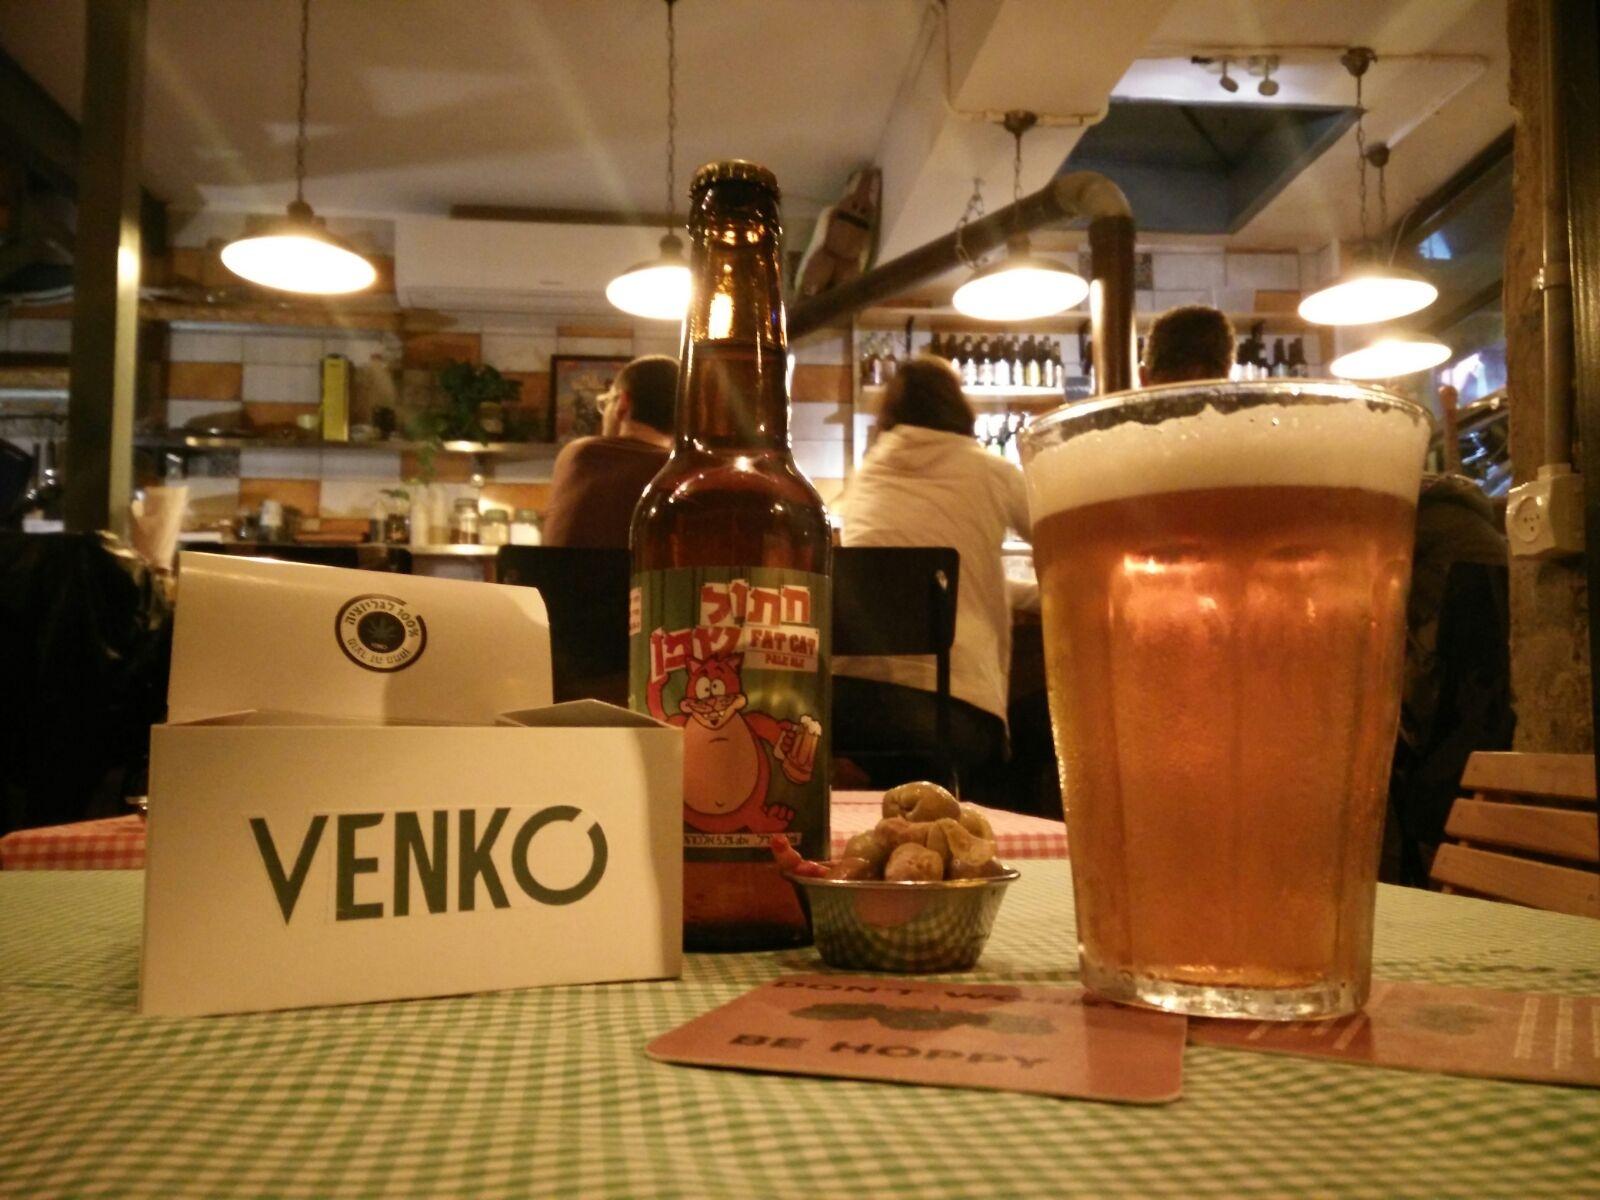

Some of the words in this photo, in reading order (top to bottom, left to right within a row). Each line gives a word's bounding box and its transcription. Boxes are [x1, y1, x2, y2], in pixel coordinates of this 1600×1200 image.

[700, 579, 811, 627] חתול
[750, 628, 786, 651] FAT
[789, 633, 816, 656] CAT
[249, 804, 608, 925] VENKO
[729, 1033, 808, 1049] BE
[829, 1040, 1050, 1070] HOPPY
